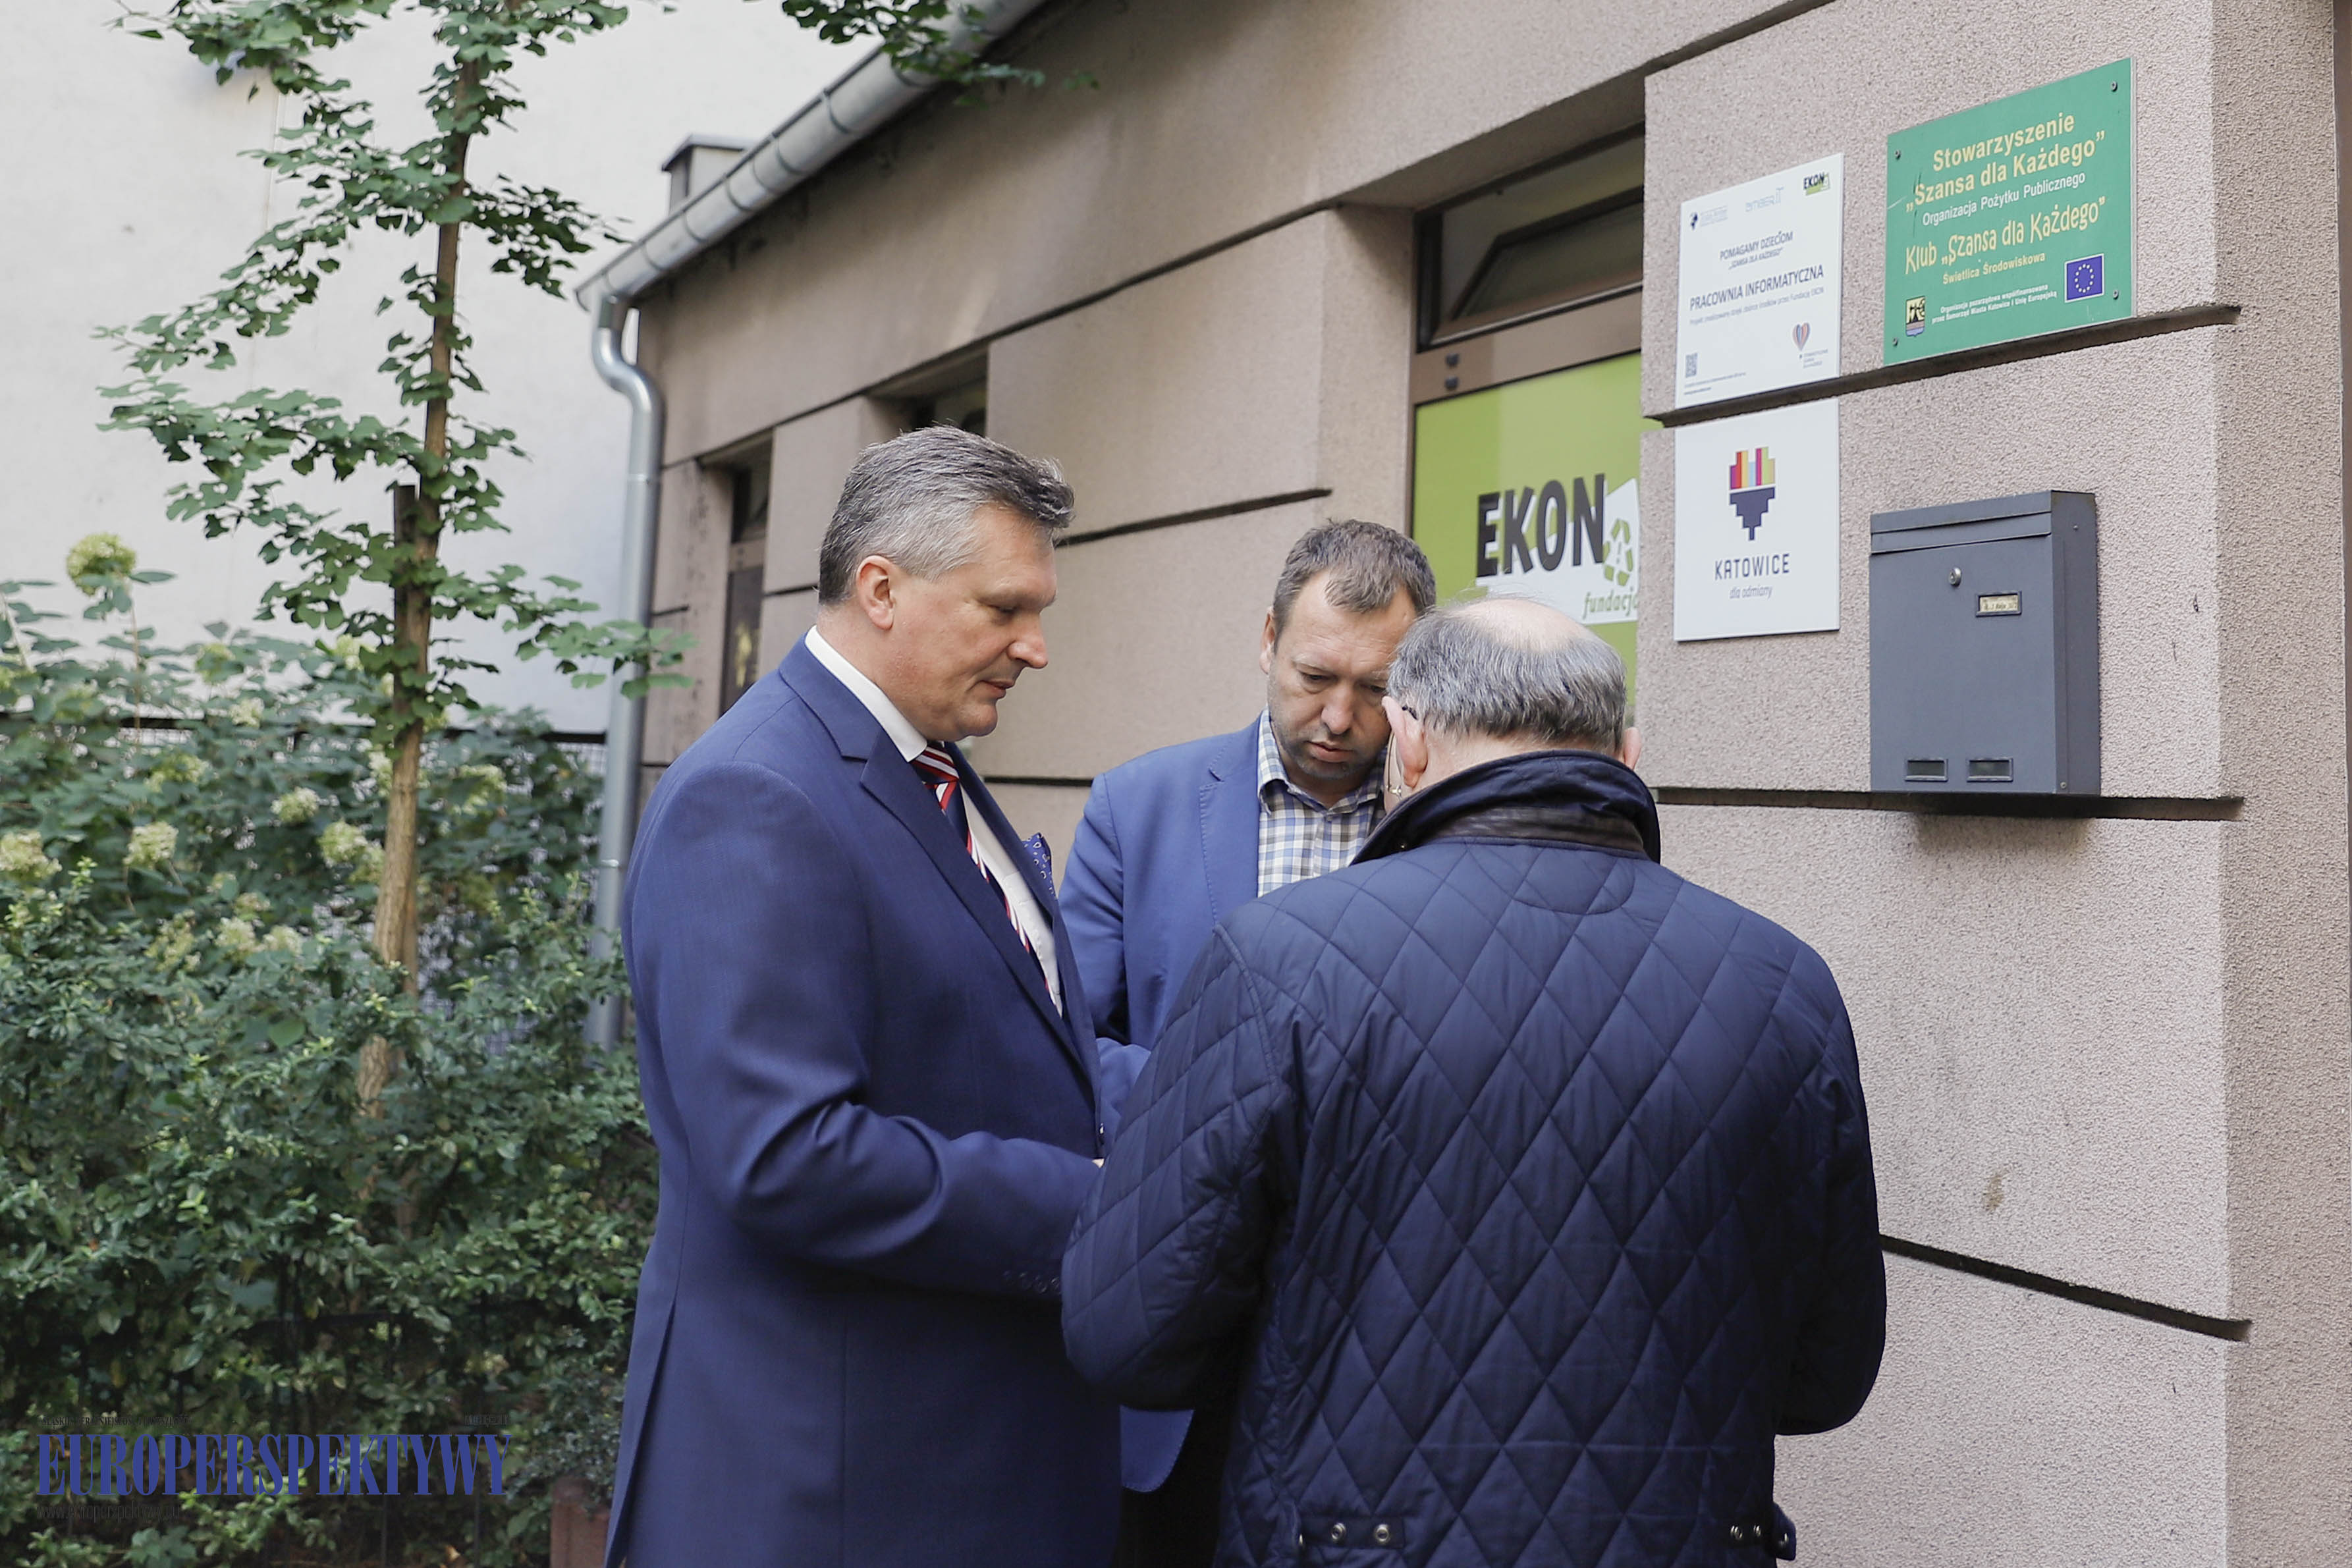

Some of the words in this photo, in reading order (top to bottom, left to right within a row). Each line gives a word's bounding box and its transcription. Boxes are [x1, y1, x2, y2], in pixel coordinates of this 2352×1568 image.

[1933, 112, 2075, 171] Stowarzyszenie
[1803, 172, 1825, 190] EKON
[1905, 171, 1975, 212] „Szansa
[1981, 161, 2007, 188] dla
[2013, 130, 2105, 177] Każdego”
[1923, 201, 1977, 227] Organizacja
[1981, 188, 2020, 210] Pożytku
[2023, 172, 2085, 197] Publicznego
[1720, 241, 1759, 260] POMAGAMY
[1761, 230, 1793, 249] DZIECIOM
[1905, 241, 1937, 275] Klub
[1941, 228, 1997, 266] „Szansa
[2002, 220, 2024, 246] dla
[2030, 196, 2105, 243] Każdego”
[1943, 268, 1980, 284] Świetlica
[1983, 253, 2045, 275] Środowiskowa
[1690, 284, 1743, 311] PRACOWNIA
[1745, 264, 1824, 296] INFORMATYCZNA
[1940, 301, 1968, 313] Organizacja
[1988, 301, 2010, 311] Katowice
[1477, 473, 1604, 578] EKON
[1715, 554, 1790, 581] KATOWICE
[1730, 585, 1740, 599] dla
[1742, 583, 1772, 600] odmiany
